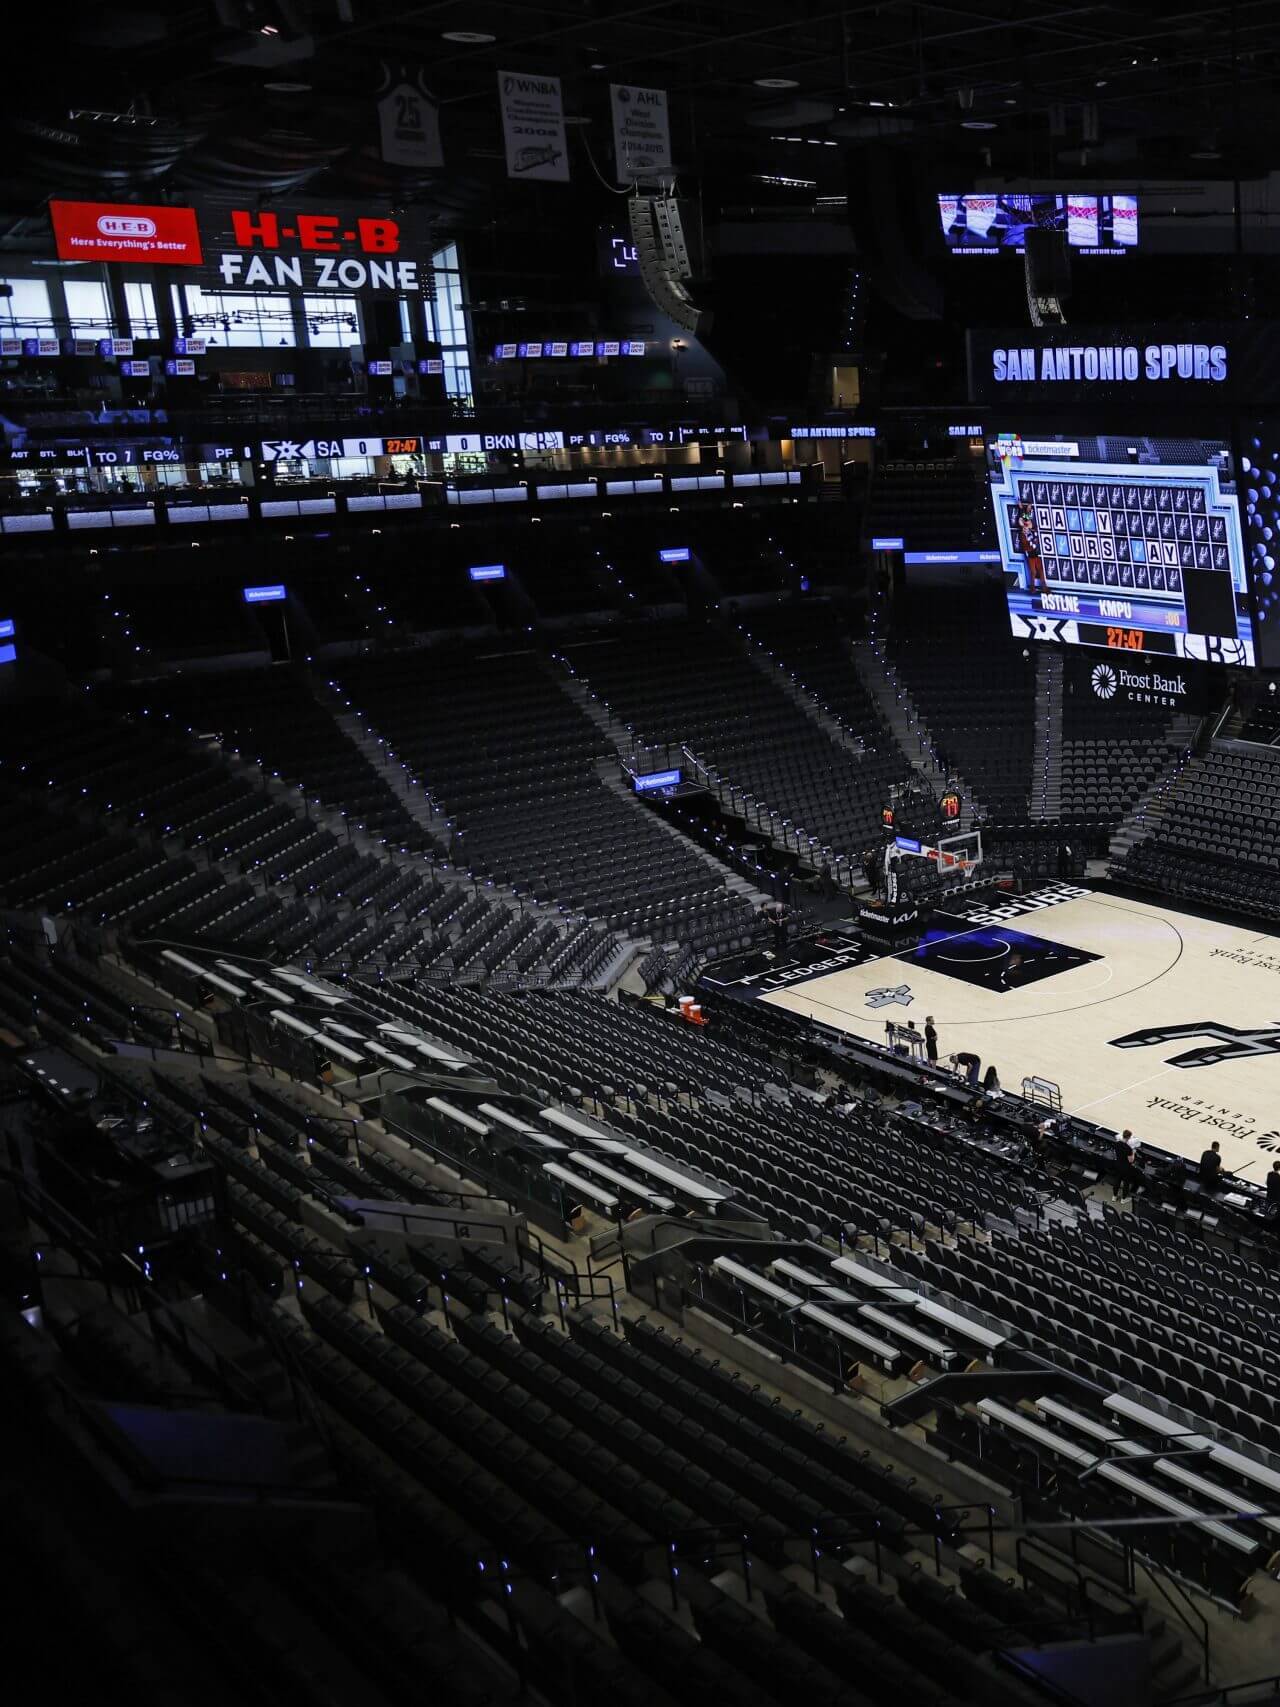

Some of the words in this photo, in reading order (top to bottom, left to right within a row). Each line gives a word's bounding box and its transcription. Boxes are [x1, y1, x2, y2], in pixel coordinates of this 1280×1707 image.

[517, 80, 559, 96] WNBA
[637, 92, 662, 106] AHL
[70, 237, 95, 248] Here
[97, 238, 155, 250] Everything's
[157, 240, 187, 251] Better
[220, 254, 300, 287] FAN
[315, 258, 419, 290] ZONE
[993, 349, 1036, 381] SAN
[1041, 347, 1138, 381] ANTONIO
[1145, 344, 1227, 381] SPURS
[96, 452, 117, 463] TO
[144, 450, 179, 461] FG%
[215, 448, 233, 458] PF
[318, 441, 341, 457] SA
[359, 438, 368, 455] 0
[387, 439, 417, 453] 27:47
[461, 435, 468, 450] 0
[485, 435, 516, 449] BKN
[570, 436, 584, 444] PF
[605, 434, 630, 443] FG%
[650, 432, 663, 441] TO
[1028, 445, 1071, 454] ticketmaster
[1041, 593, 1080, 613] RSTLNE
[1099, 599, 1132, 619] KMPU
[1107, 627, 1144, 650] 27:47
[1119, 669, 1150, 689] Frost
[1153, 673, 1187, 695] Bank
[1128, 692, 1175, 706] CENTER
[967, 886, 1092, 925] SPURS
[765, 955, 857, 984] LEDGER
[1146, 1096, 1202, 1120] Bank
[1181, 1095, 1256, 1124] CENTER
[1199, 1114, 1257, 1139] Frost
